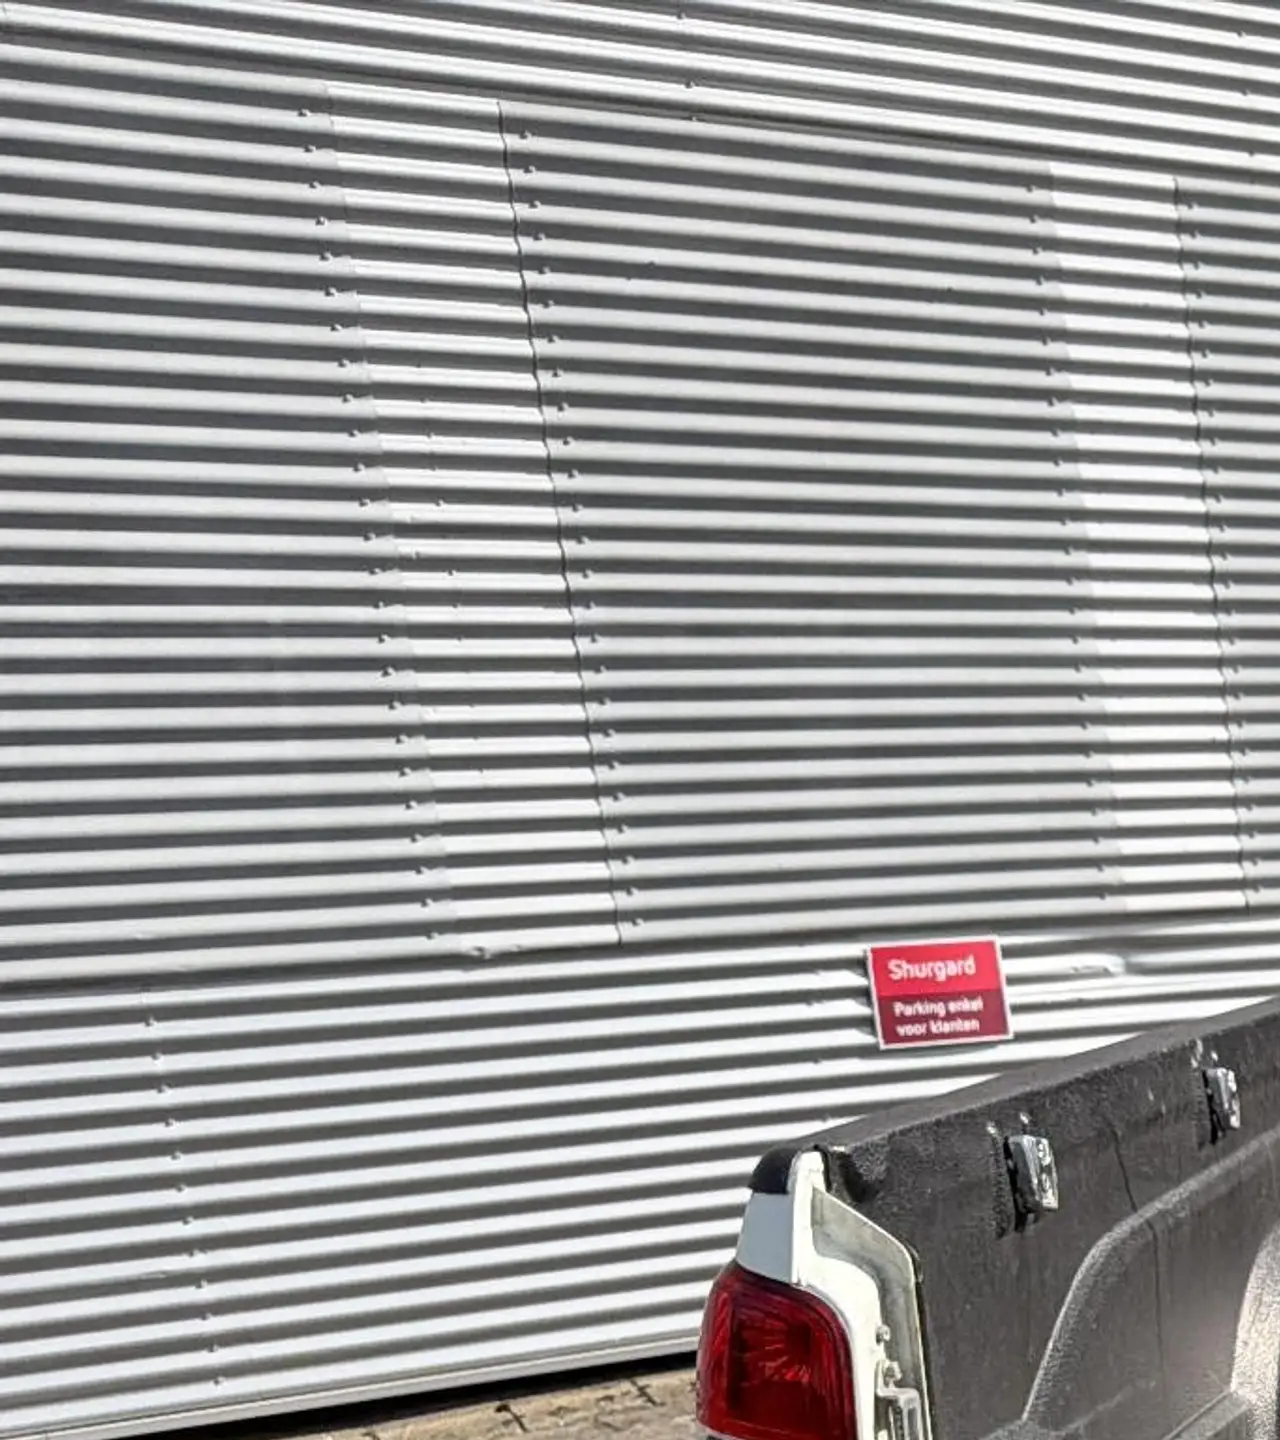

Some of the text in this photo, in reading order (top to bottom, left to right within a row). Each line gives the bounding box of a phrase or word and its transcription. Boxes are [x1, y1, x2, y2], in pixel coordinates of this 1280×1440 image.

[886, 954, 976, 982] Shurgard
[893, 997, 984, 1018] Parking enkel
[896, 1018, 980, 1037] voor klanten
